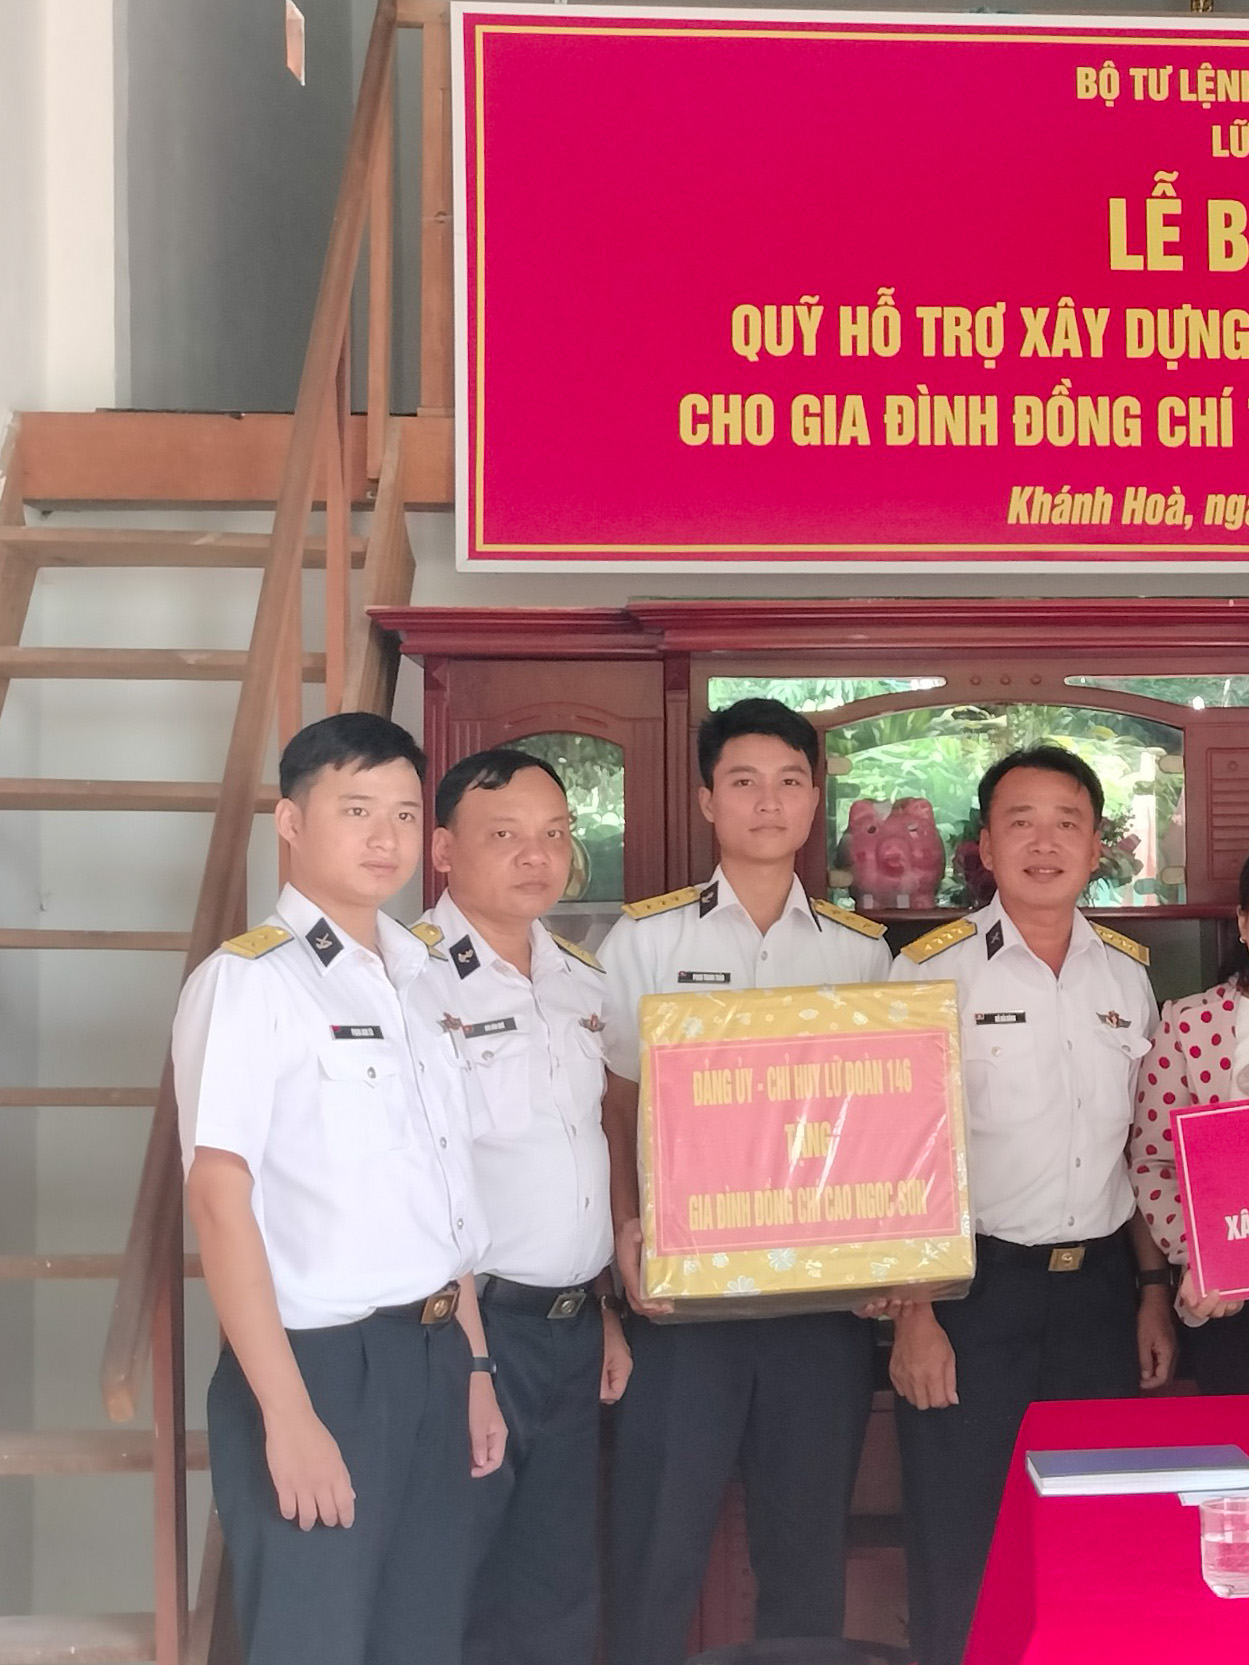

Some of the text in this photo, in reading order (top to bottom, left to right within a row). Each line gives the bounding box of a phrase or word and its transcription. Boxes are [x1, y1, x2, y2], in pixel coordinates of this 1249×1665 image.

[1077, 61, 1119, 106] BỘ
[1130, 66, 1172, 100] TƯ
[1110, 171, 1183, 270] LỄ
[732, 296, 823, 361] QUỸ
[840, 288, 900, 357] HỖ
[916, 302, 1005, 368] TRỢ
[1020, 297, 1109, 357] XÂY
[680, 394, 774, 445] CHO
[792, 394, 870, 446] GIA
[884, 385, 997, 445] ĐÌNH
[1013, 379, 1141, 446] ĐỒNG
[1158, 387, 1233, 447] CHÍ
[1008, 486, 1112, 524] Khánh
[1122, 486, 1193, 529] Hoà,
[735, 1057, 753, 1103] ỦY
[767, 1052, 791, 1101] CHỈ
[794, 1063, 820, 1099] HUY
[887, 1058, 912, 1093] 146
[689, 1194, 713, 1231] GIA
[717, 1185, 751, 1229] ĐÌNH
[754, 1177, 793, 1227] ĐỒNG
[825, 1184, 851, 1221] CAO
[855, 1181, 893, 1226] NGỌC
[897, 1177, 927, 1217] SƠN
